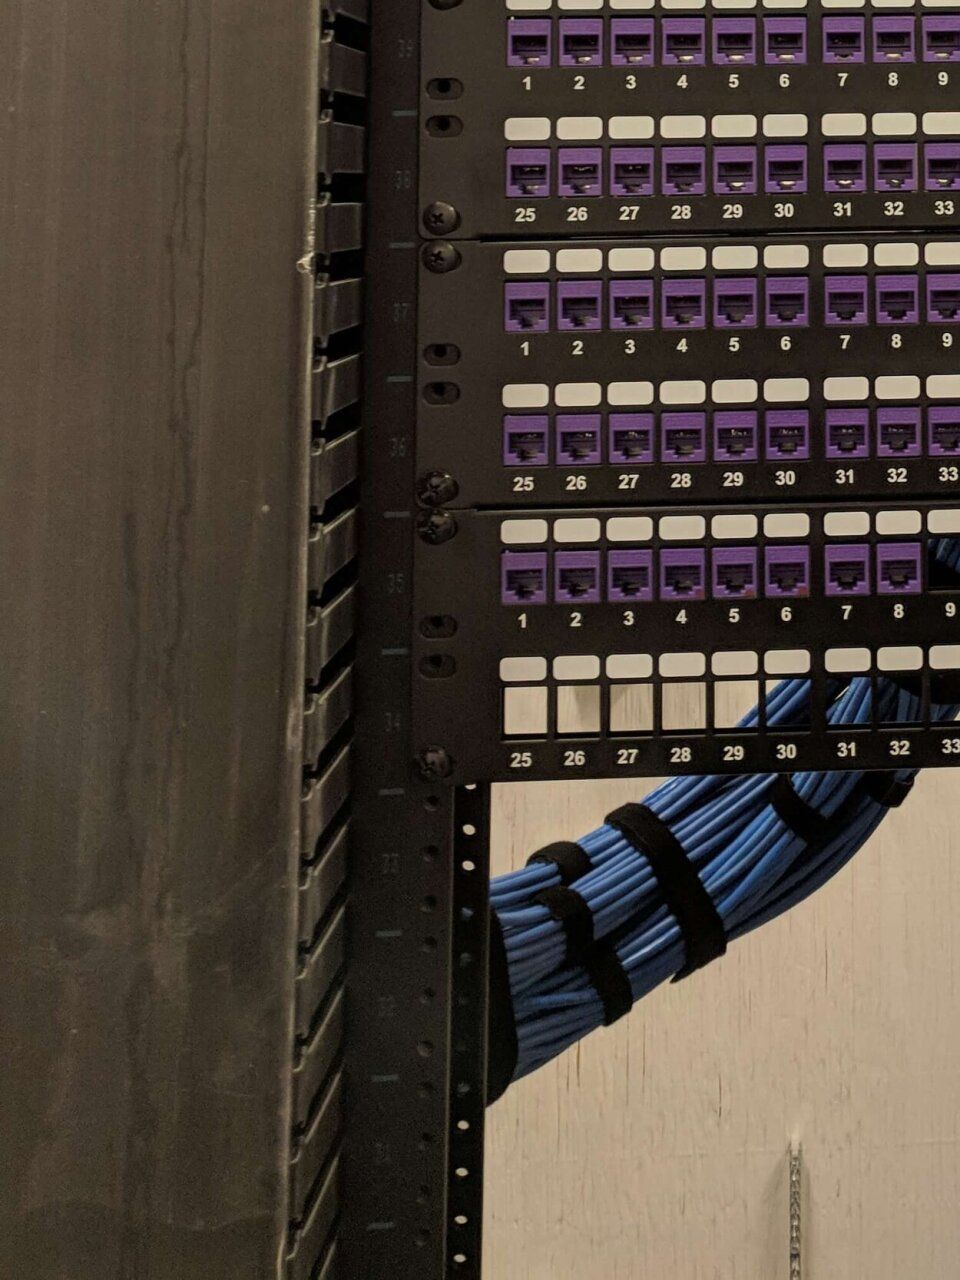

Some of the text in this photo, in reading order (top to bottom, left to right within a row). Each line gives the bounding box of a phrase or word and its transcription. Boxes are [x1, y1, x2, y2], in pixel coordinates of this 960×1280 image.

[522, 76, 531, 91] 1
[573, 75, 585, 90] 2
[625, 74, 637, 90] 3
[676, 74, 689, 89] 4
[728, 73, 740, 89] 5
[779, 73, 790, 88] 6
[837, 72, 849, 87] 7
[888, 72, 899, 87] 8
[937, 71, 949, 86] 9
[514, 207, 536, 223] 25
[566, 206, 588, 222] 26
[618, 205, 641, 221] 27
[670, 204, 692, 220] 28
[722, 203, 743, 219] 29
[774, 202, 795, 218] 30
[833, 201, 852, 217] 31
[884, 201, 905, 216] 32
[934, 200, 955, 216] 33
[520, 341, 529, 356] 1
[572, 340, 584, 355] 2
[624, 339, 636, 354] 3
[676, 338, 688, 353] 4
[728, 337, 740, 352] 5
[780, 335, 792, 351] 6
[839, 334, 851, 350] 7
[891, 333, 902, 349] 8
[942, 332, 953, 348] 9
[512, 476, 535, 492] 25
[565, 475, 587, 491] 26
[618, 474, 640, 490] 27
[670, 472, 692, 488] 28
[723, 471, 744, 487] 29
[775, 470, 796, 486] 30
[835, 468, 854, 484] 31
[887, 467, 908, 483] 32
[938, 466, 959, 482] 33
[518, 613, 527, 629] 1
[570, 611, 582, 627] 2
[623, 610, 634, 626] 3
[675, 609, 688, 624] 4
[728, 608, 740, 623] 5
[781, 606, 792, 622] 6
[841, 605, 852, 620] 7
[893, 603, 905, 619] 8
[945, 602, 956, 617] 9
[510, 752, 532, 768] 25
[564, 750, 586, 766] 26
[617, 748, 639, 765] 27
[670, 747, 692, 763] 28
[723, 745, 744, 761] 29
[776, 743, 797, 760] 30
[837, 741, 856, 757] 31
[889, 740, 910, 756] 32
